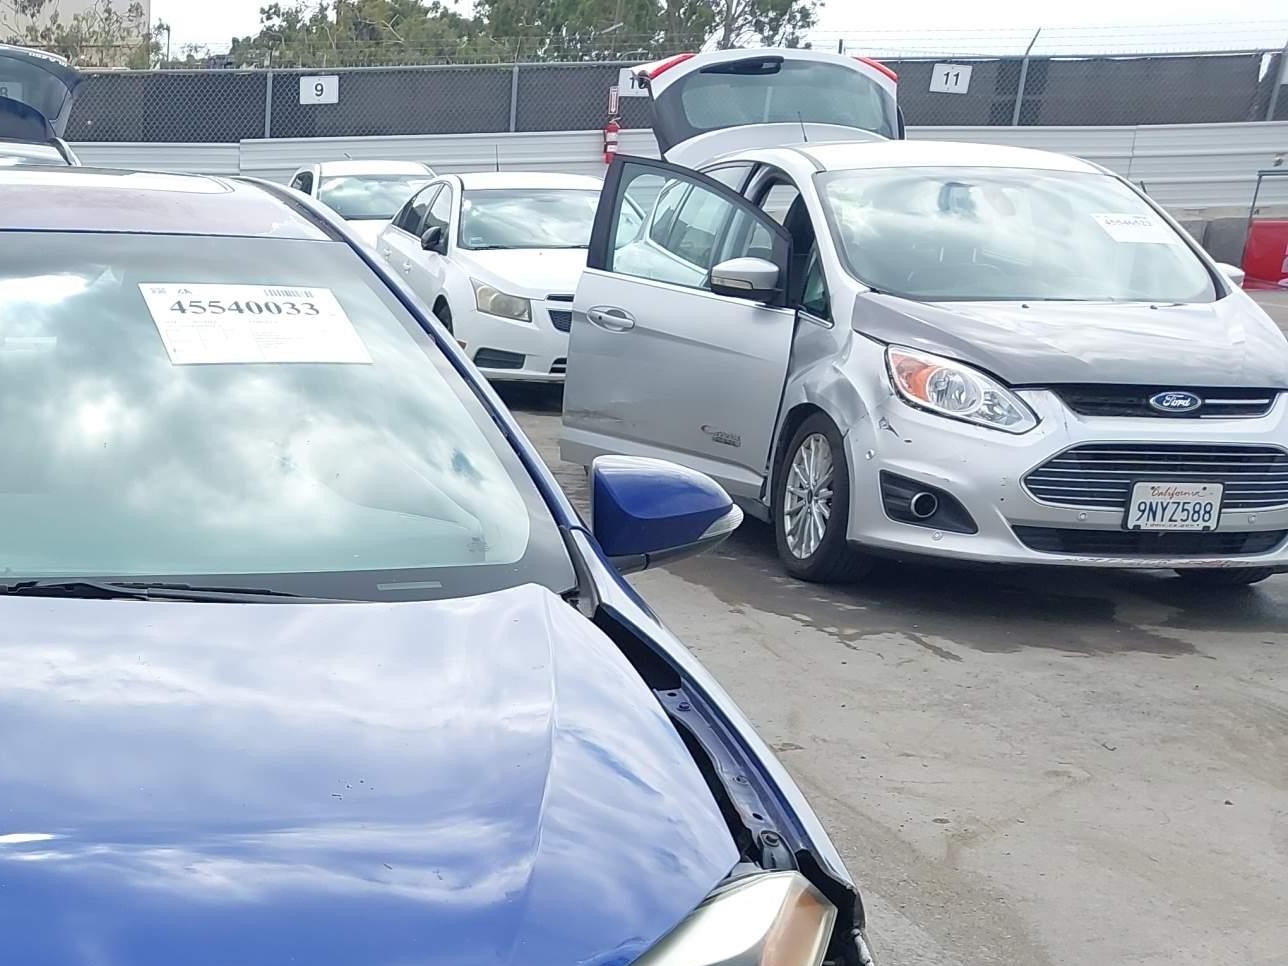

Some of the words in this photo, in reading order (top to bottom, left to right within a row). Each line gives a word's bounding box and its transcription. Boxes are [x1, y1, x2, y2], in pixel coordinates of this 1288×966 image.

[943, 71, 960, 86] 11
[314, 82, 324, 97] 9
[169, 299, 321, 316] 45540033
[1162, 394, 1191, 407] Ford
[1151, 485, 1206, 500] California
[1135, 501, 1214, 523] 9NYZ588
